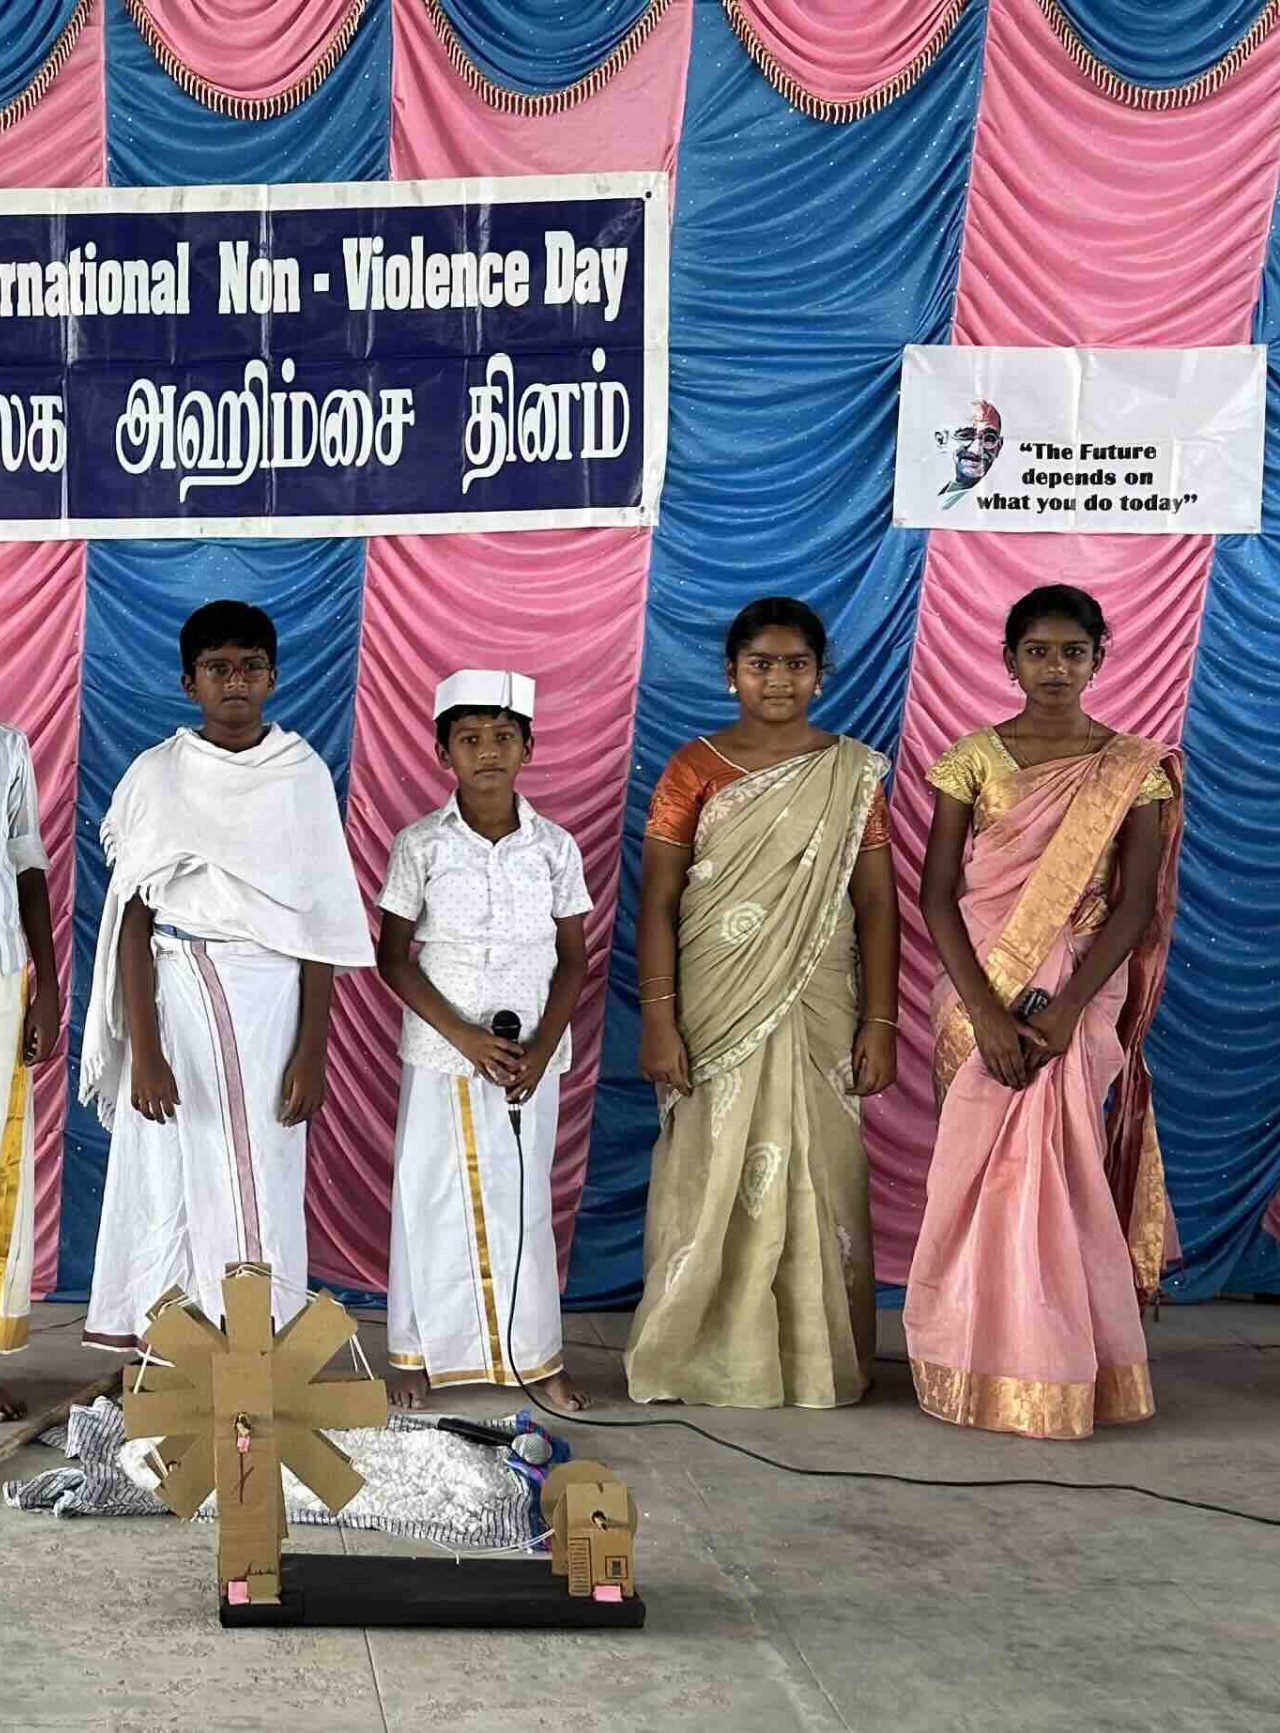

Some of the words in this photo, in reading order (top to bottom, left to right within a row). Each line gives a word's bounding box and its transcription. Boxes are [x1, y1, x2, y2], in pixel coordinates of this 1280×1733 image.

[218, 240, 301, 315] Non
[342, 235, 530, 311] Violence
[544, 230, 628, 321] Day
[115, 358, 415, 503] அஹிம்சை
[462, 347, 630, 495] தினம்
[1019, 442, 1073, 461] “The
[1080, 443, 1157, 460] Future
[1022, 468, 1117, 489] depends
[1124, 472, 1154, 486] on
[977, 494, 1030, 511] what
[1036, 497, 1076, 514] you
[1083, 494, 1113, 511] do
[1119, 493, 1198, 514] today”
